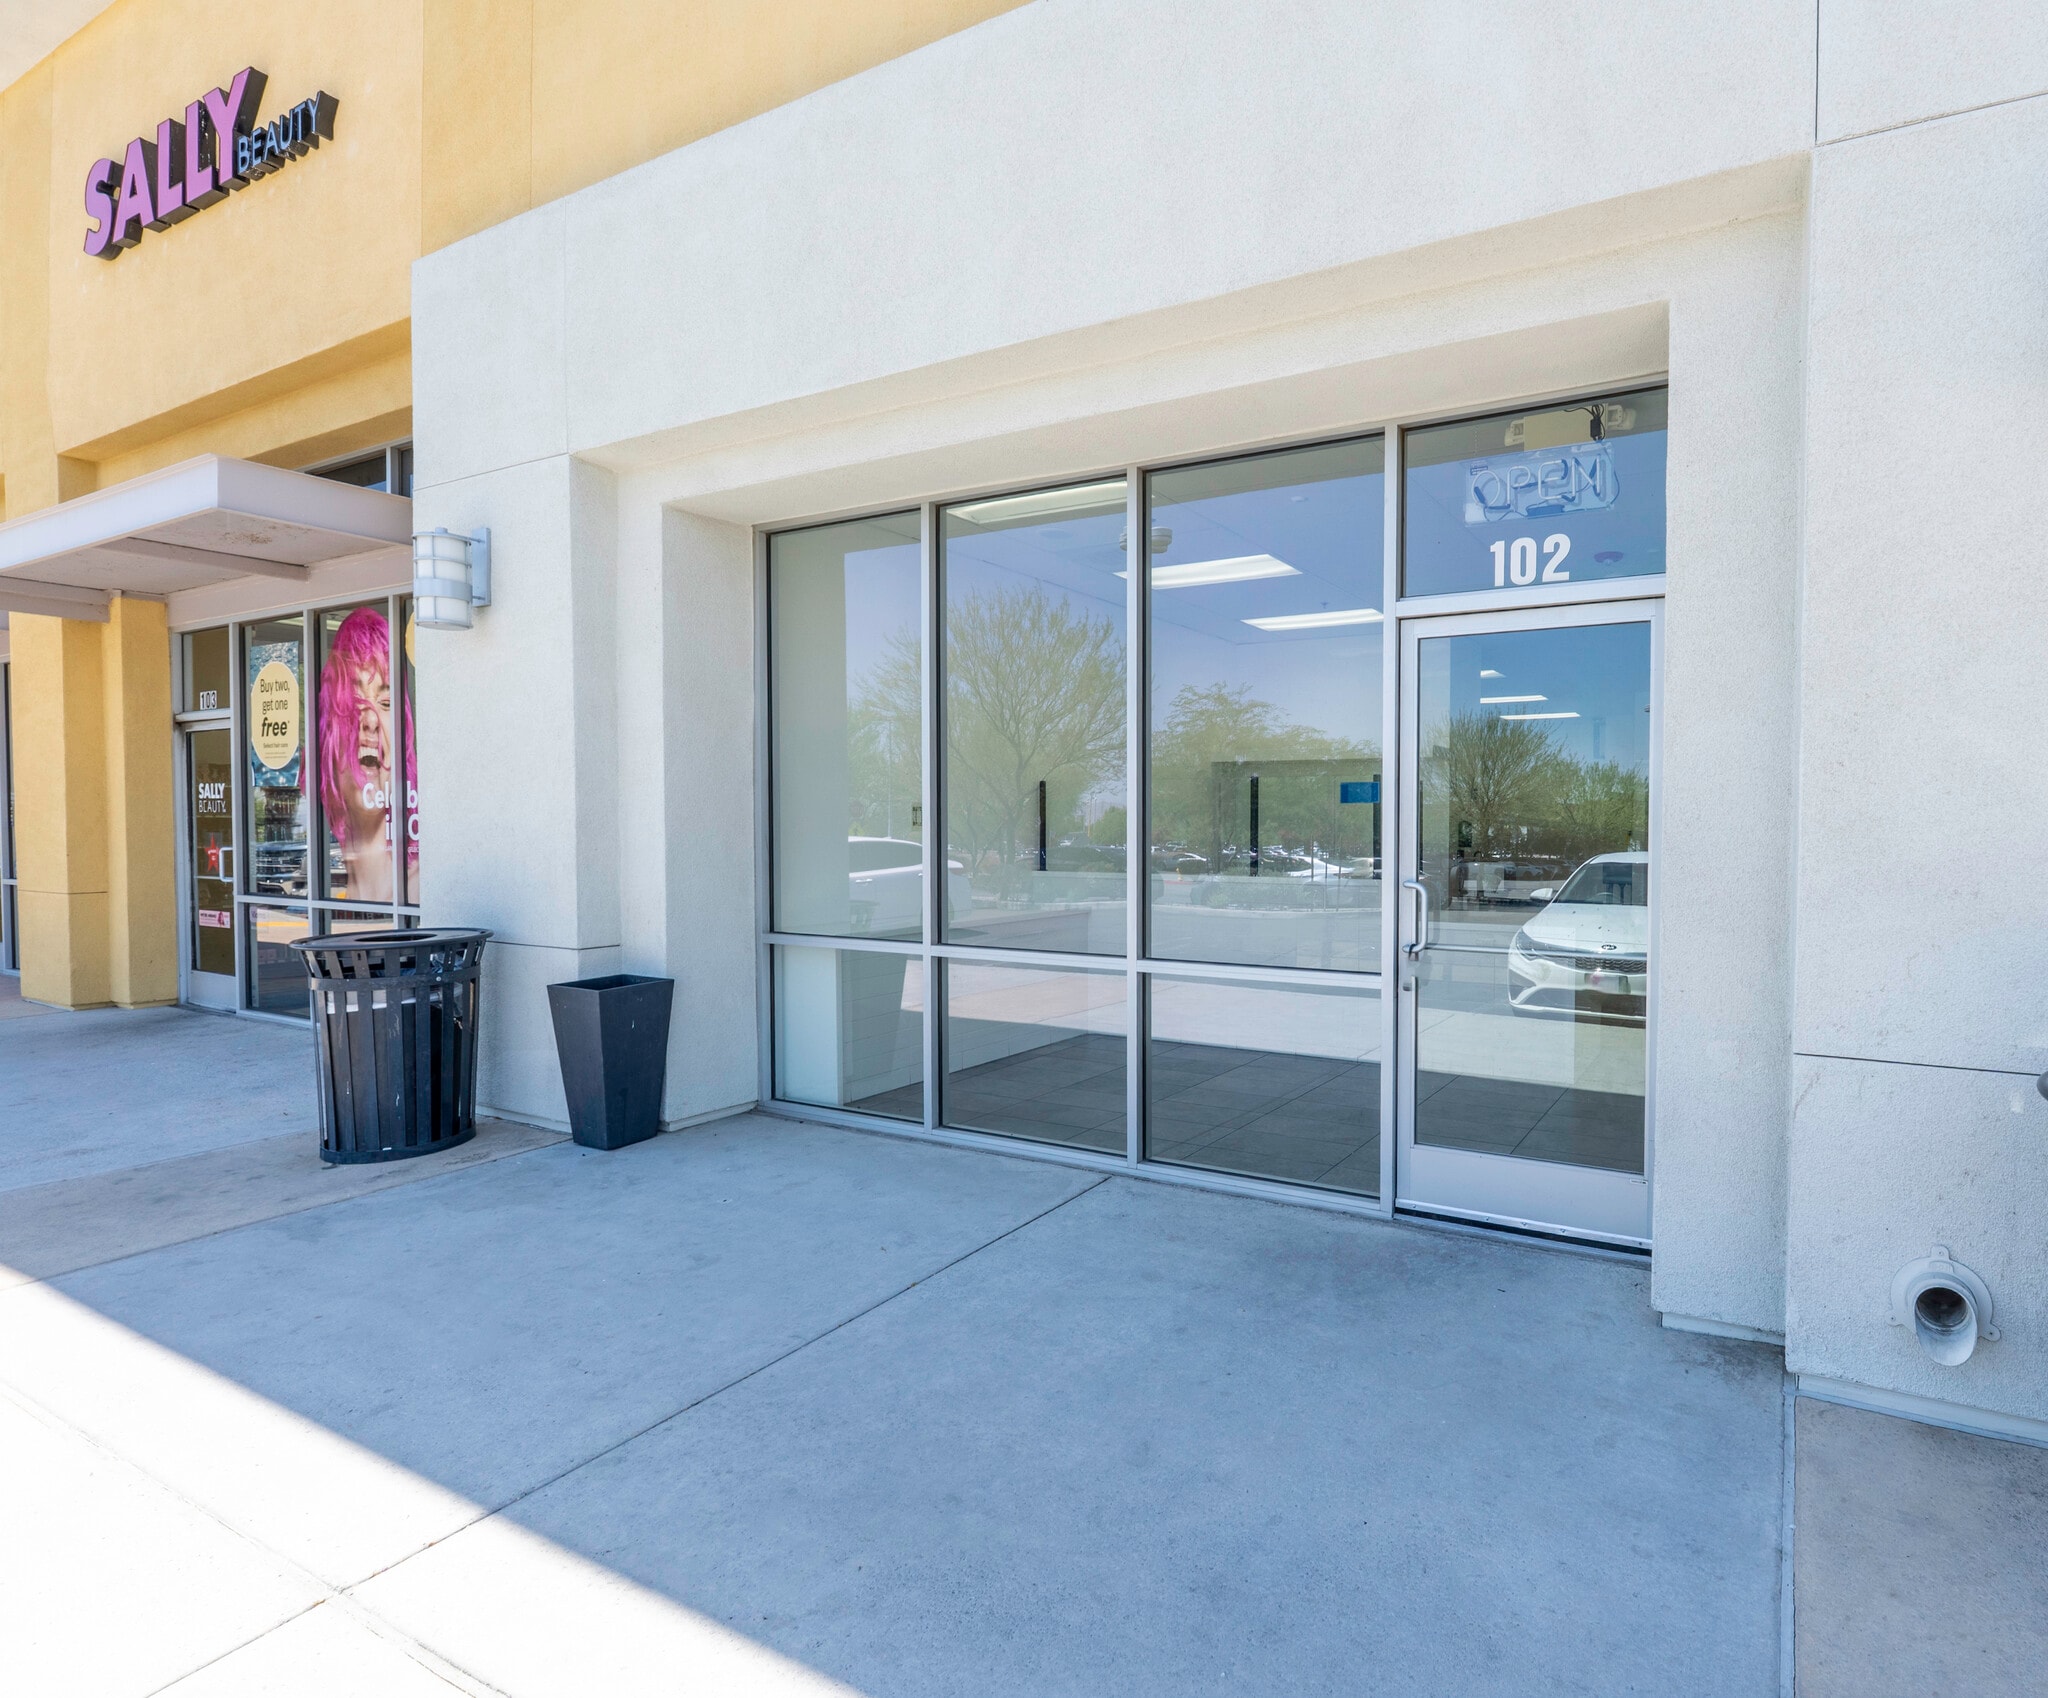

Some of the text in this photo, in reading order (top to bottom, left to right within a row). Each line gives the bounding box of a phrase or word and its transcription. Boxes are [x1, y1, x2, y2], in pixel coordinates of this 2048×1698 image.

[238, 90, 330, 177] BEAUTY
[84, 66, 262, 258] SALLY
[1471, 456, 1602, 505] OPEN
[1489, 533, 1571, 587] 102
[200, 691, 217, 709] 103
[260, 678, 290, 695] Buy two,
[262, 699, 288, 715] get one
[198, 783, 225, 799] SALLY
[362, 781, 418, 809] Celb
